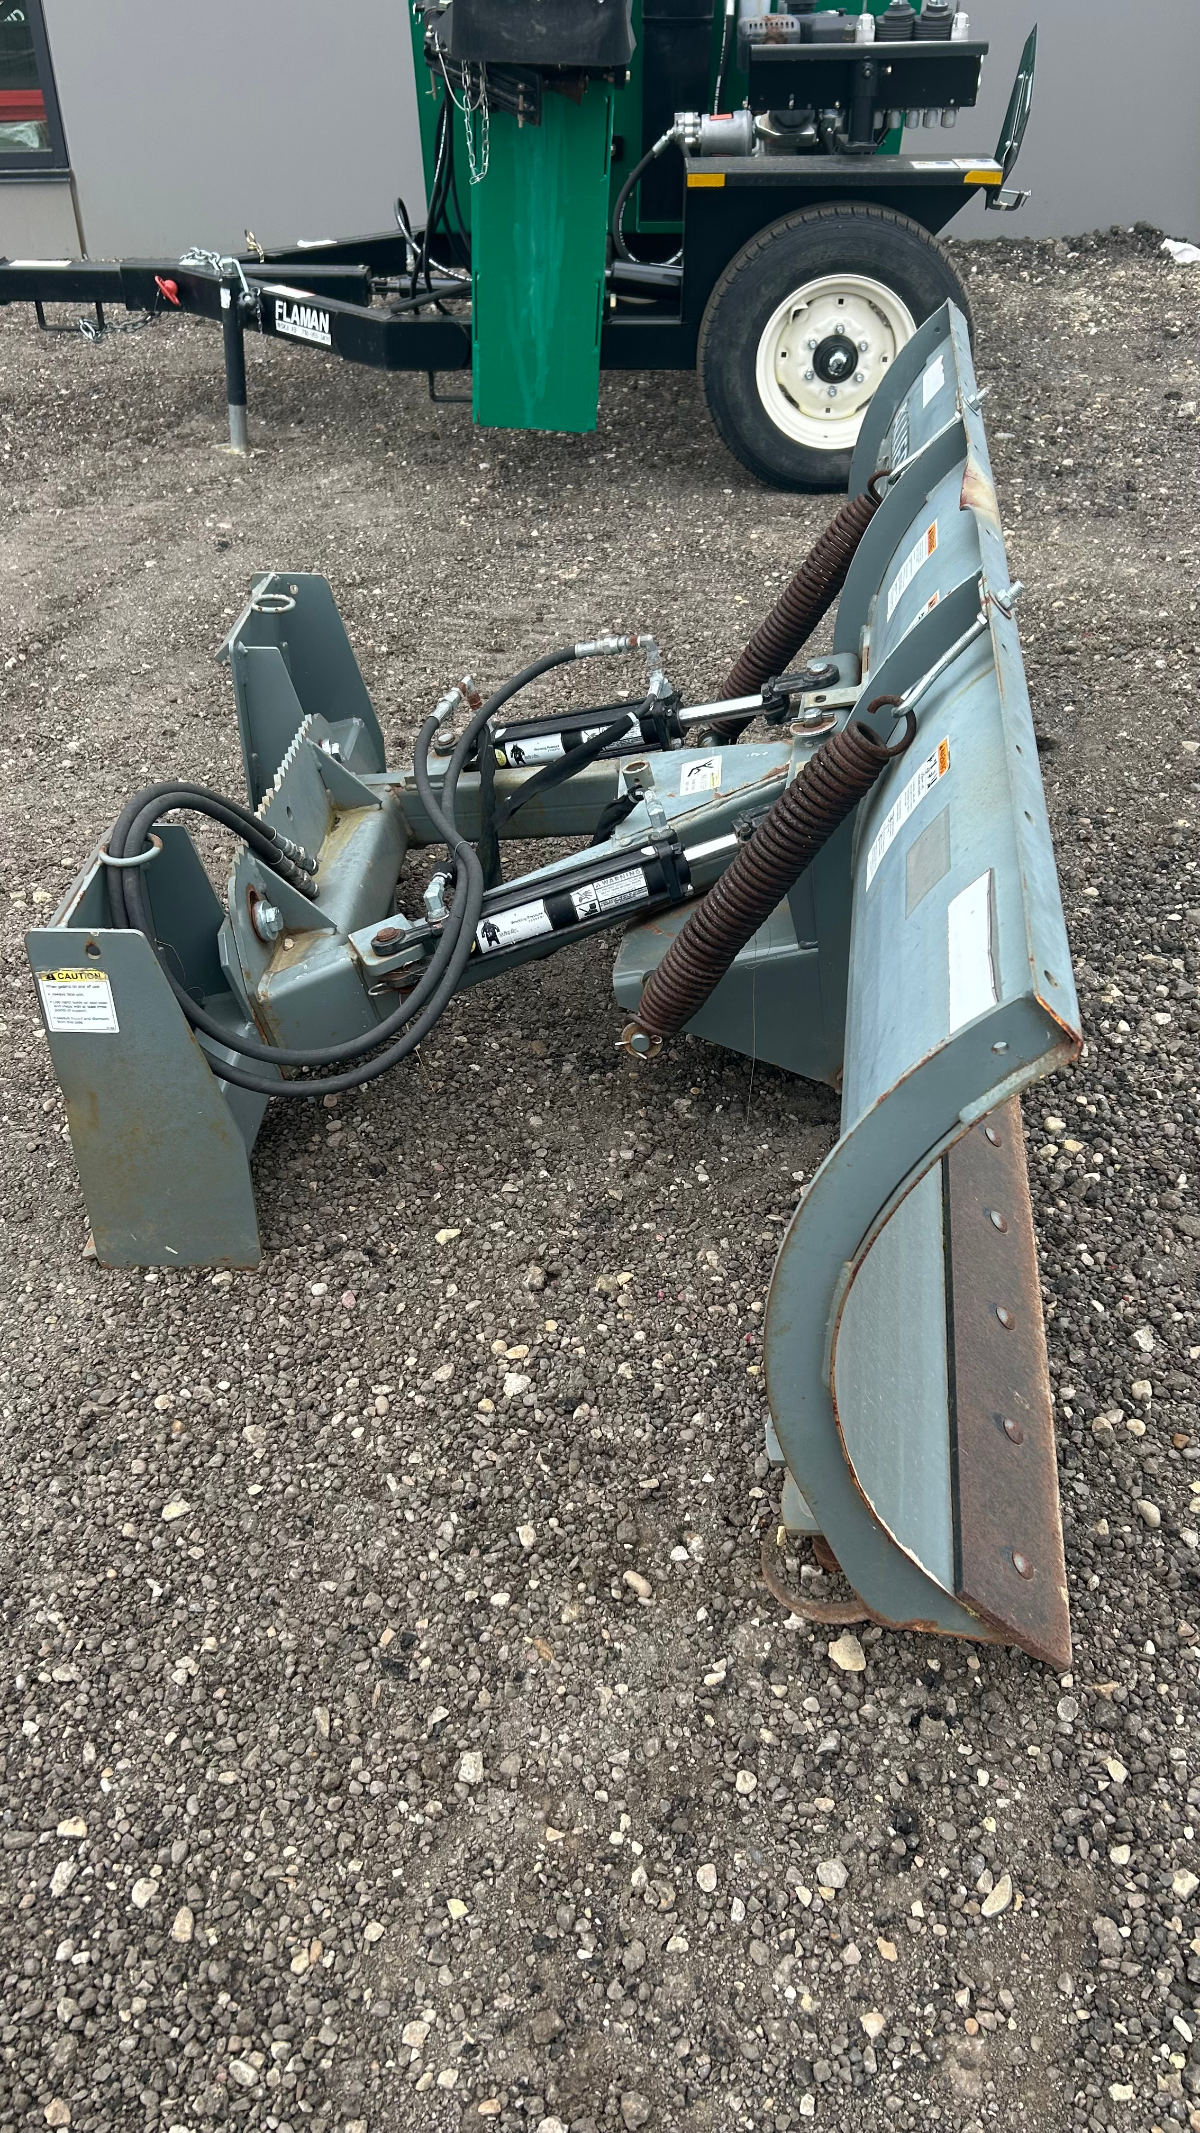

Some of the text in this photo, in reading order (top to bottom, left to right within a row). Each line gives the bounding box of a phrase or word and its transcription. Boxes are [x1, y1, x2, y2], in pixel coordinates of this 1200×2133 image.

[275, 299, 330, 334] FLAMAN
[601, 869, 641, 885] WARNING
[57, 972, 101, 981] CAUTION
